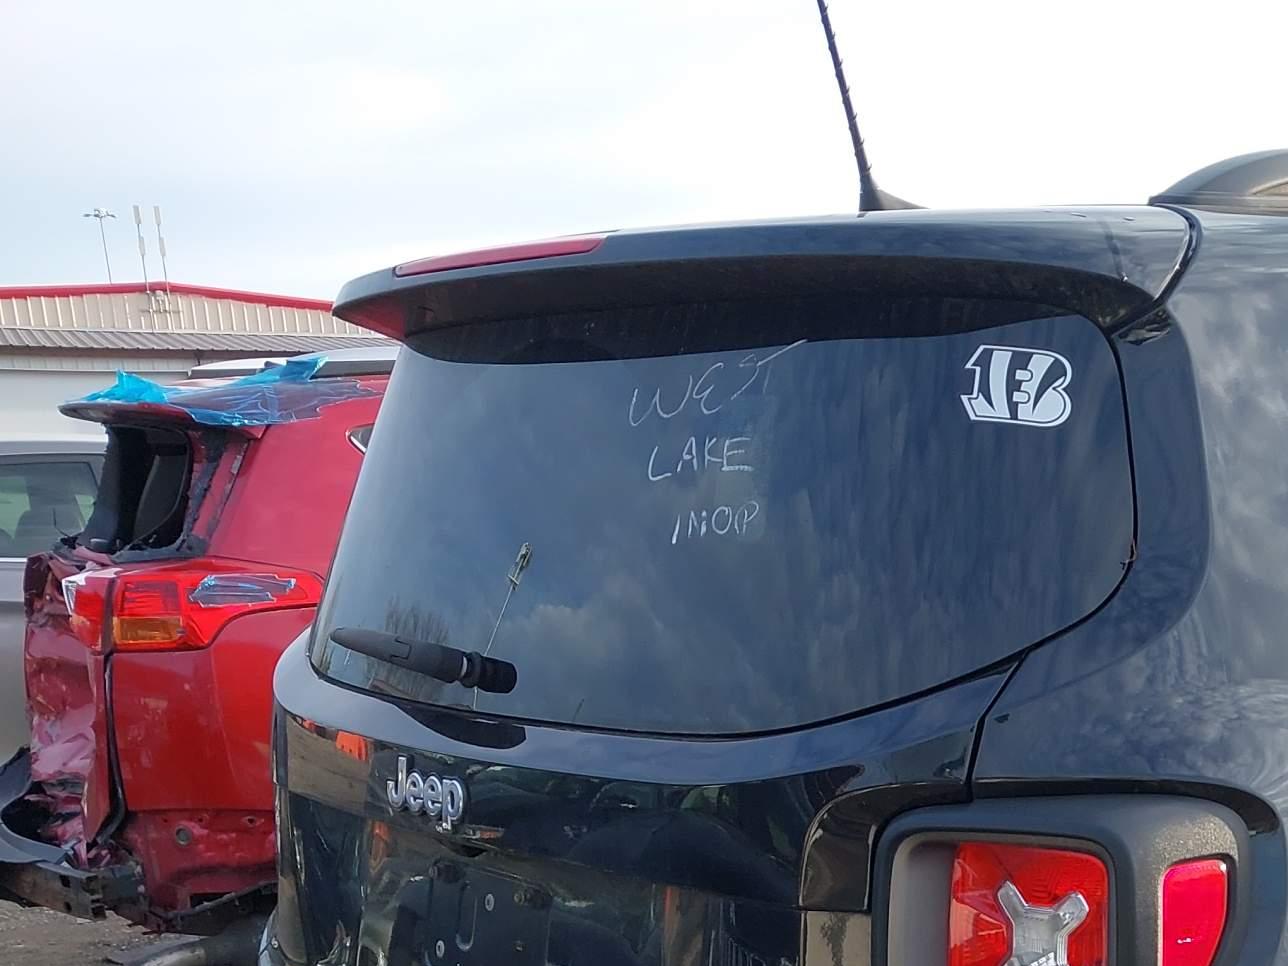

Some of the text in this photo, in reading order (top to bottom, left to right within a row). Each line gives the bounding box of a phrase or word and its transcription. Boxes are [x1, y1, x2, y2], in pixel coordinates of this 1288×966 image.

[628, 338, 807, 427] WEST
[648, 436, 753, 481] LAKE
[386, 755, 465, 824] Jeep
